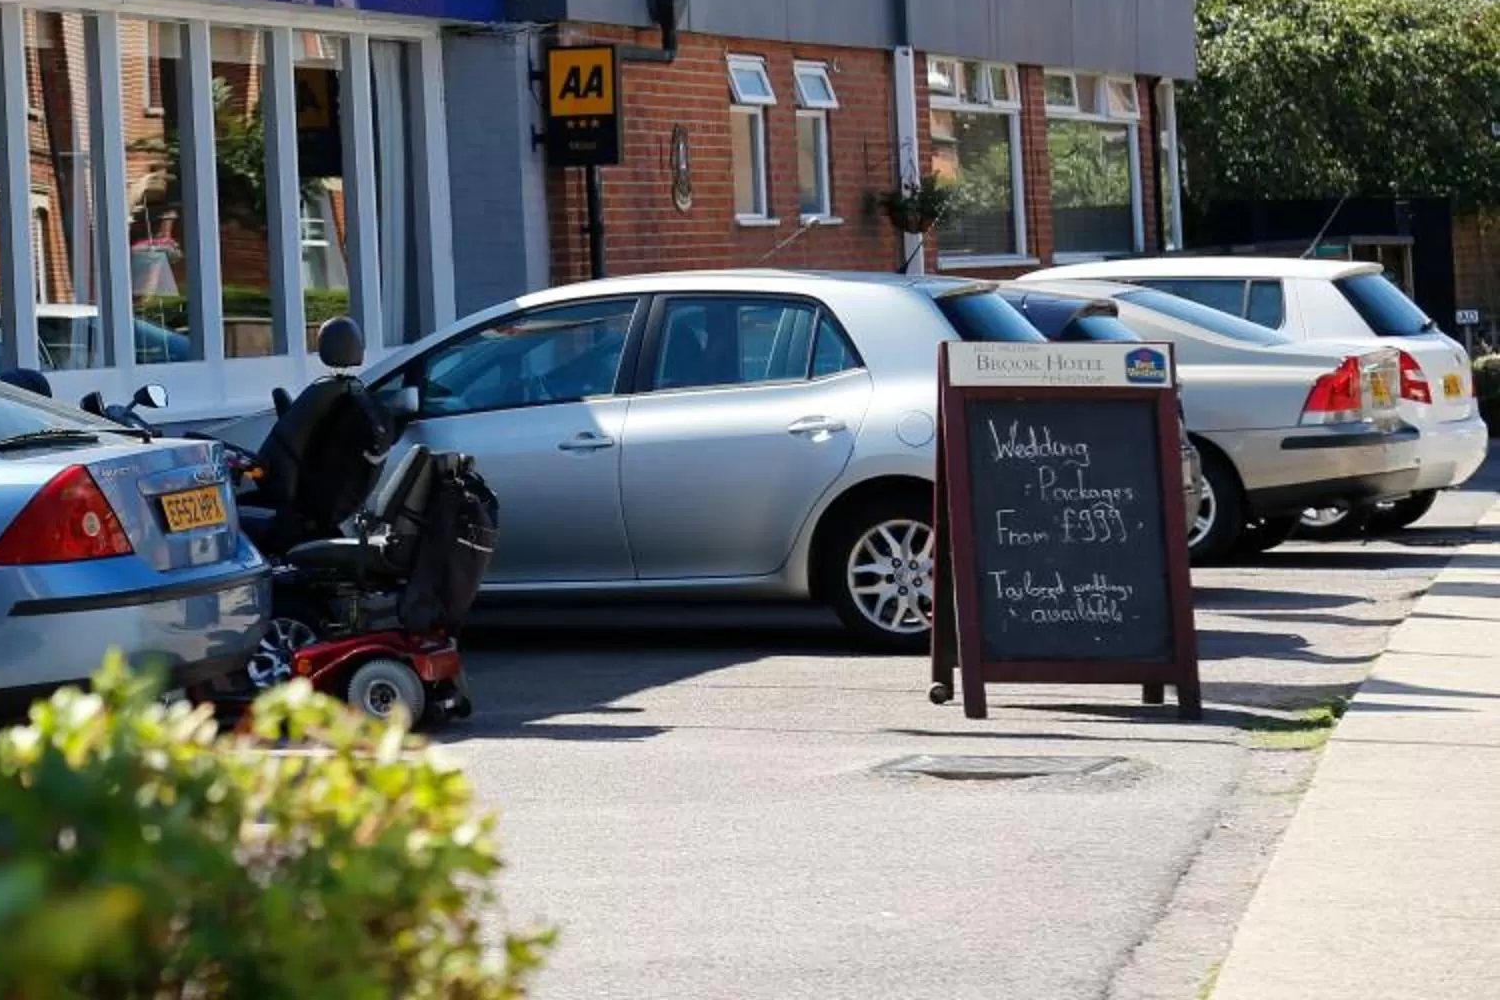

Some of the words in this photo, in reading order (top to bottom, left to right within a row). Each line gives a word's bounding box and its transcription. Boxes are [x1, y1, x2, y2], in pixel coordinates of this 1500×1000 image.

[558, 63, 604, 100] AA
[976, 353, 1041, 373] BROOK
[1046, 353, 1105, 372] HOTEL
[988, 420, 1091, 466] Wedding
[1037, 465, 1134, 508] Packages
[996, 509, 1049, 545] From
